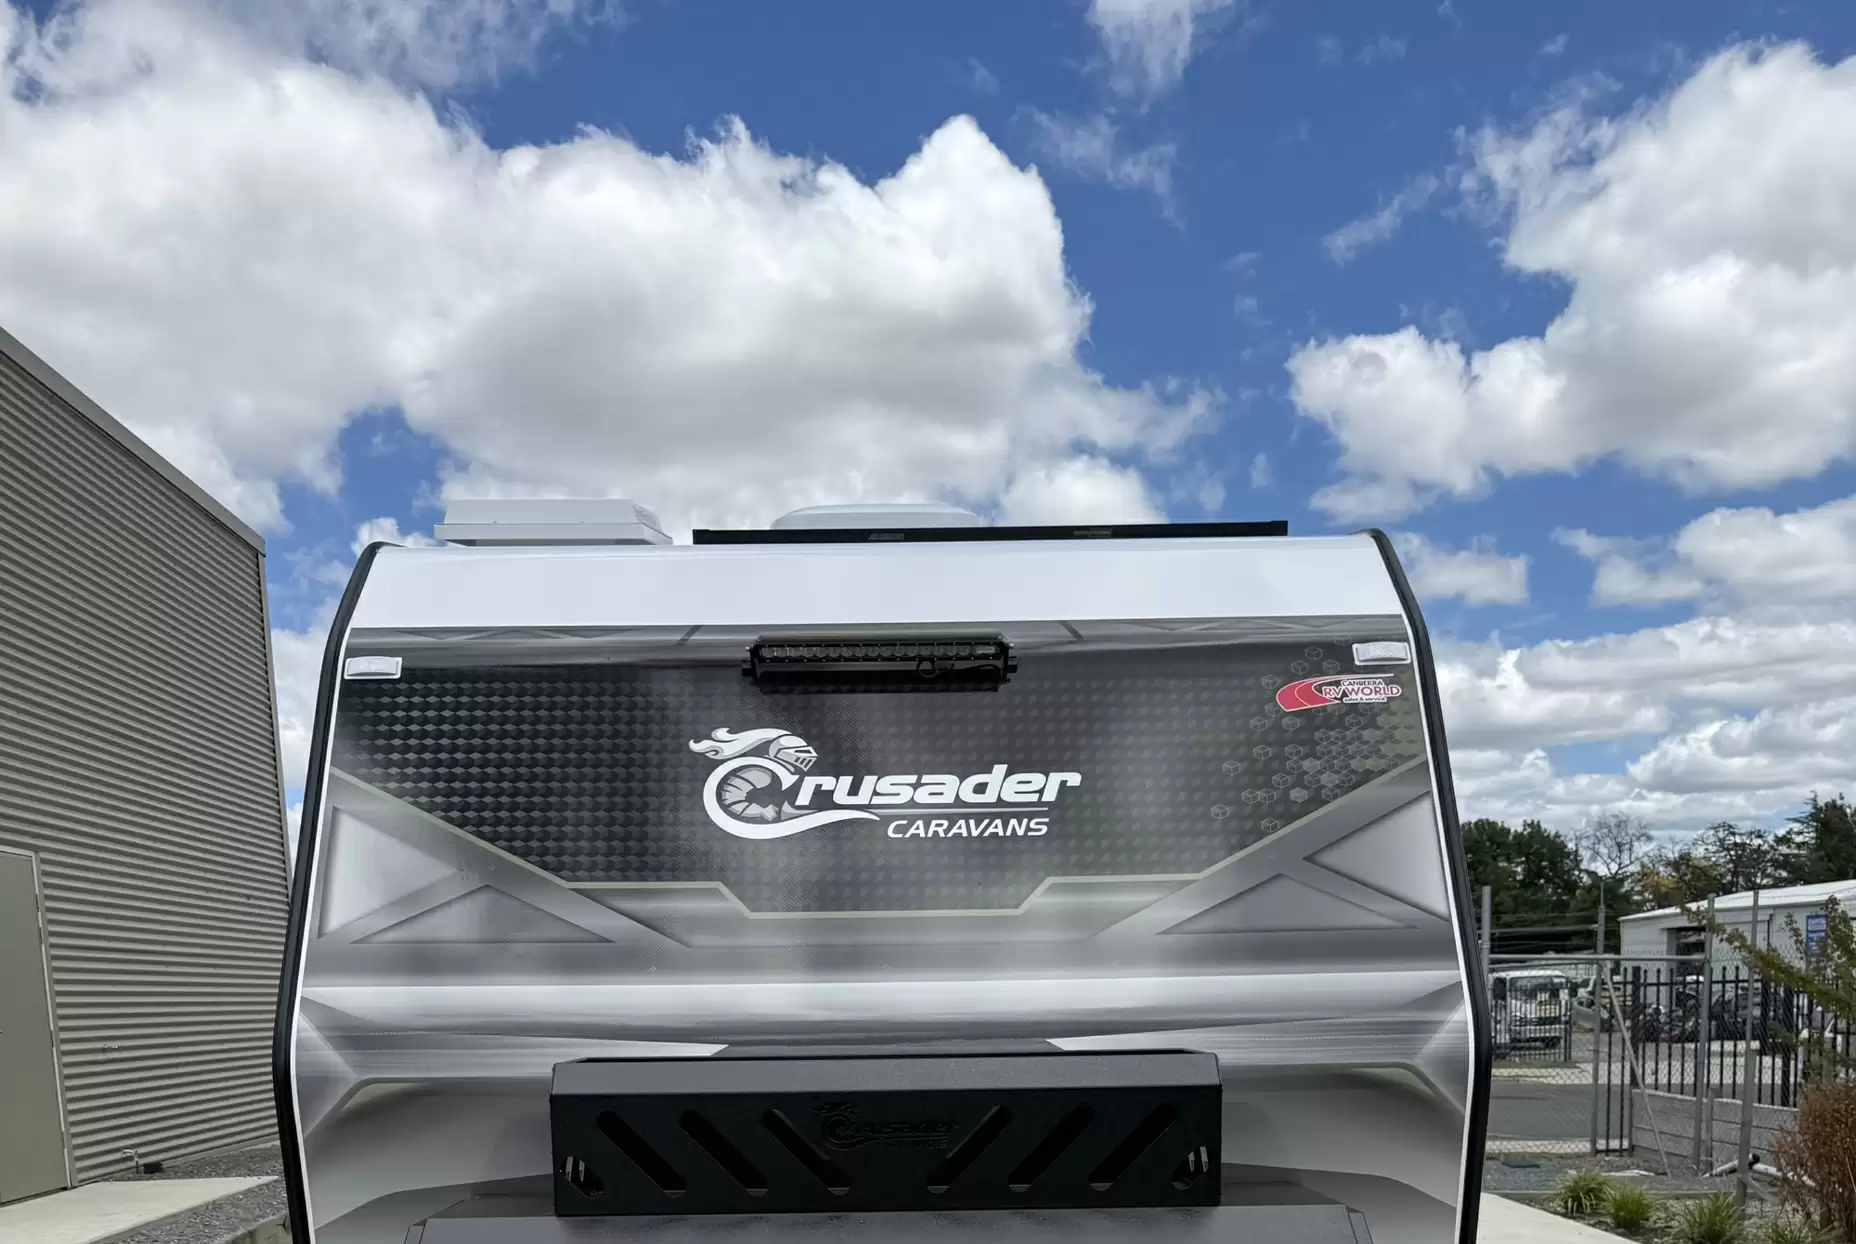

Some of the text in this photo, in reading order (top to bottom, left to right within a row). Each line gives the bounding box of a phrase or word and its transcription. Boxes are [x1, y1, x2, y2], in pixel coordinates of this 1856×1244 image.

[1324, 686, 1400, 698] RV WORLD
[703, 757, 1082, 840] Crusader
[887, 818, 1050, 839] CARAVANS
